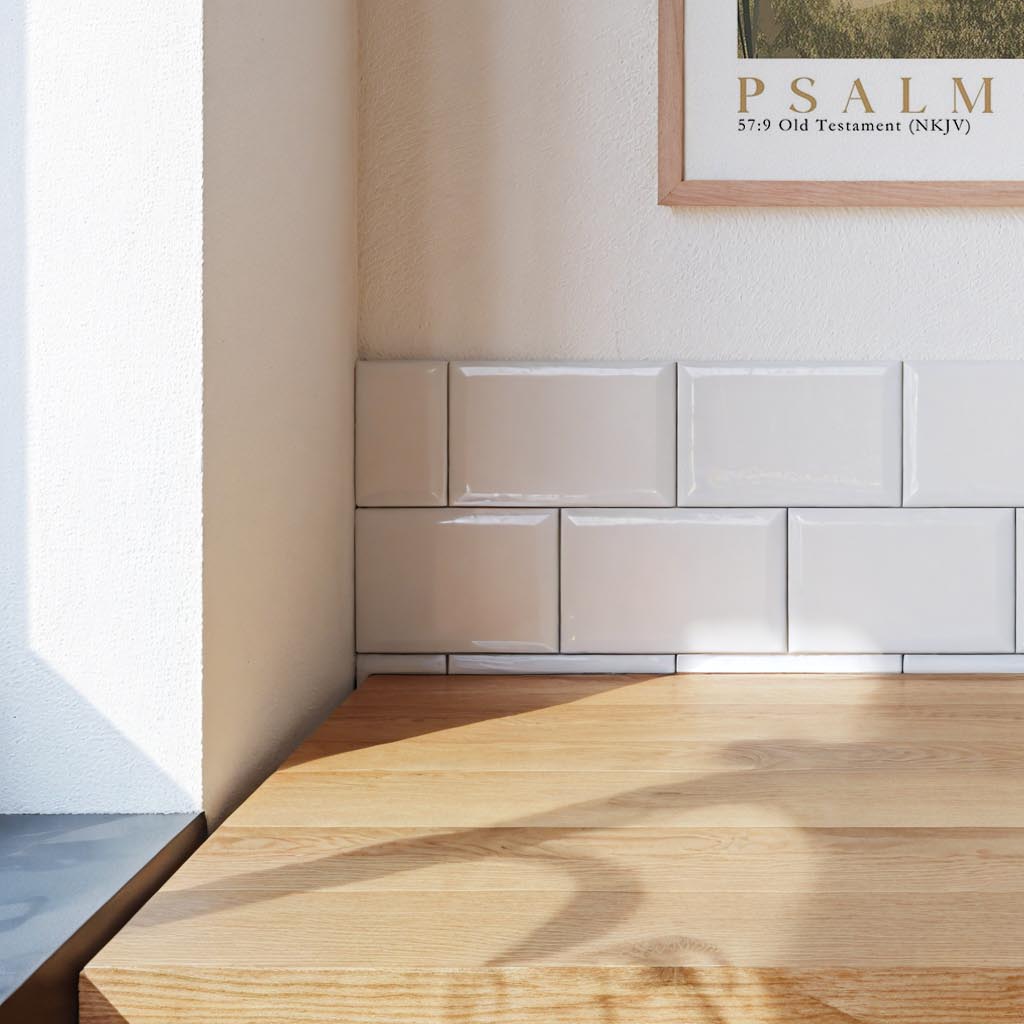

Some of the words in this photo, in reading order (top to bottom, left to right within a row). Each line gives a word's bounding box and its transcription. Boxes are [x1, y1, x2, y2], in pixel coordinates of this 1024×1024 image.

[738, 77, 994, 113] PSALM
[738, 118, 771, 132] 57:9
[779, 118, 809, 132] Old
[816, 118, 902, 132] Testament
[908, 118, 971, 136] (NKJV)
